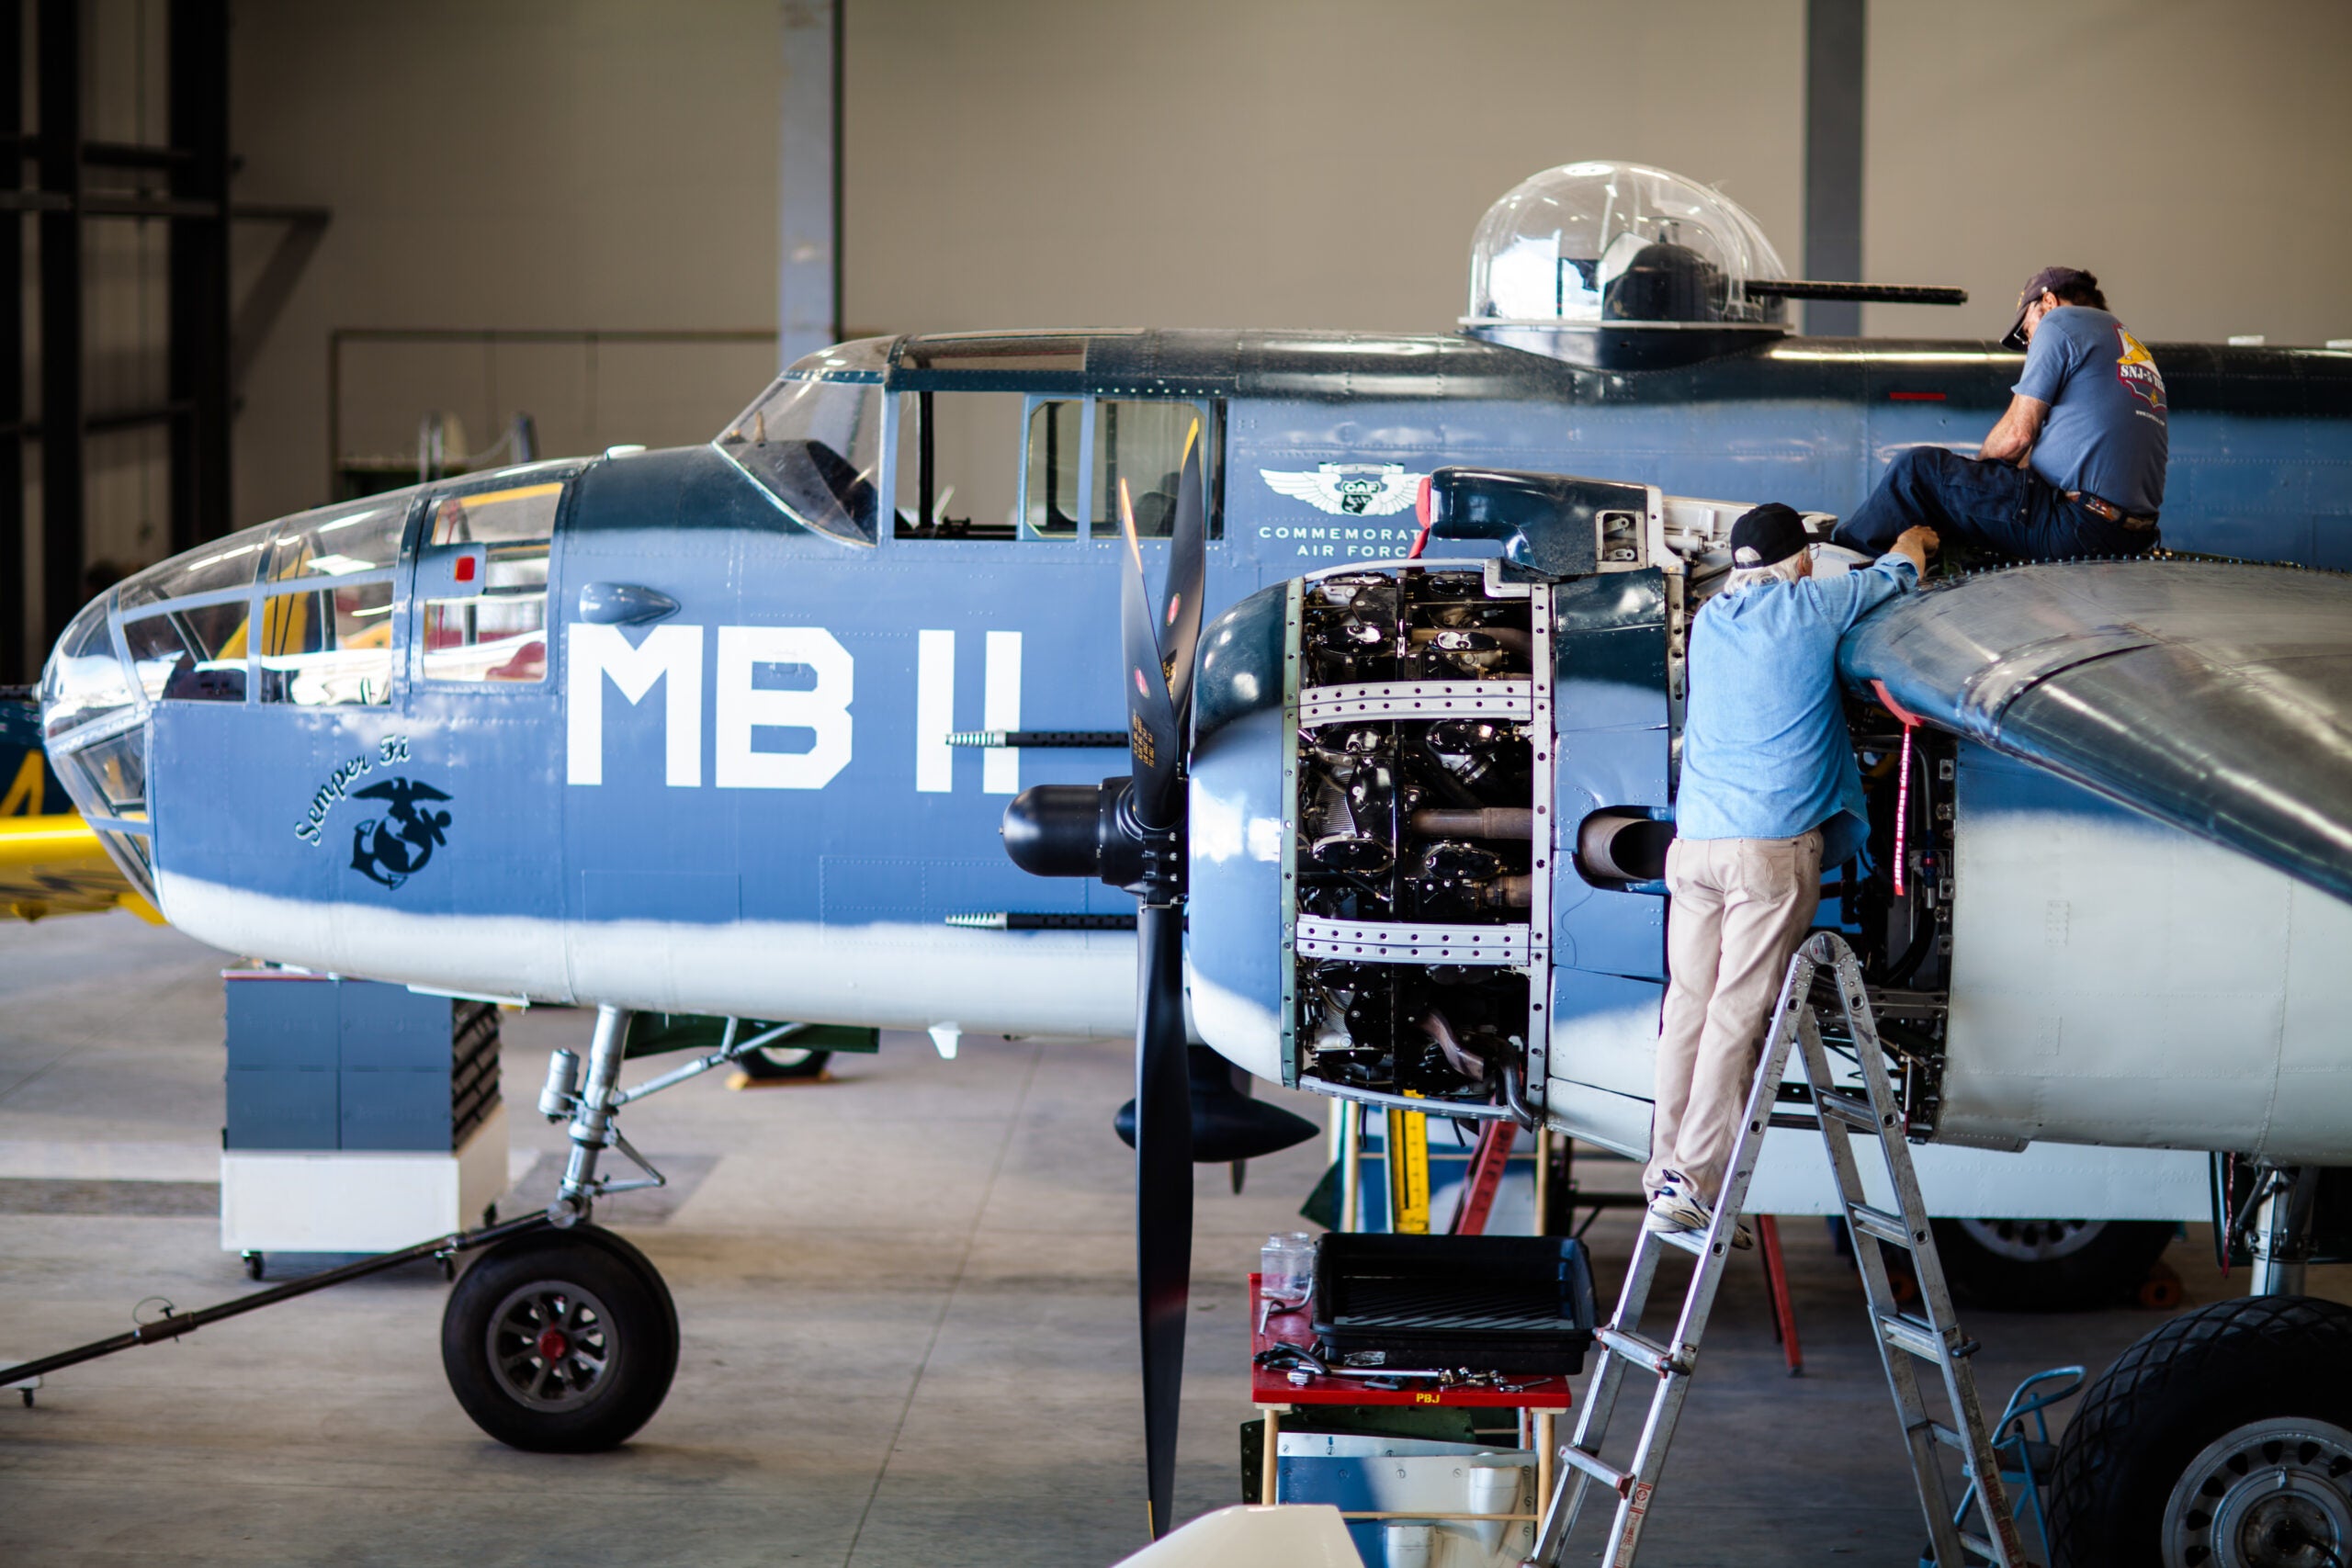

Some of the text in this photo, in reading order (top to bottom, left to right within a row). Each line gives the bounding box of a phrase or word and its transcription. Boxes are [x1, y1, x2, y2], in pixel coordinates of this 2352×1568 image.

[1343, 483, 1377, 493] CAF
[1259, 526, 1462, 542] COMMEMORAT
[1297, 545, 1408, 558] AIR FORC
[567, 623, 854, 790] MB
[295, 735, 411, 846] Semper Fi
[1894, 733, 1910, 886] REMOVE BEFORE FLIGHT
[1416, 1393, 1441, 1404] PBJ
